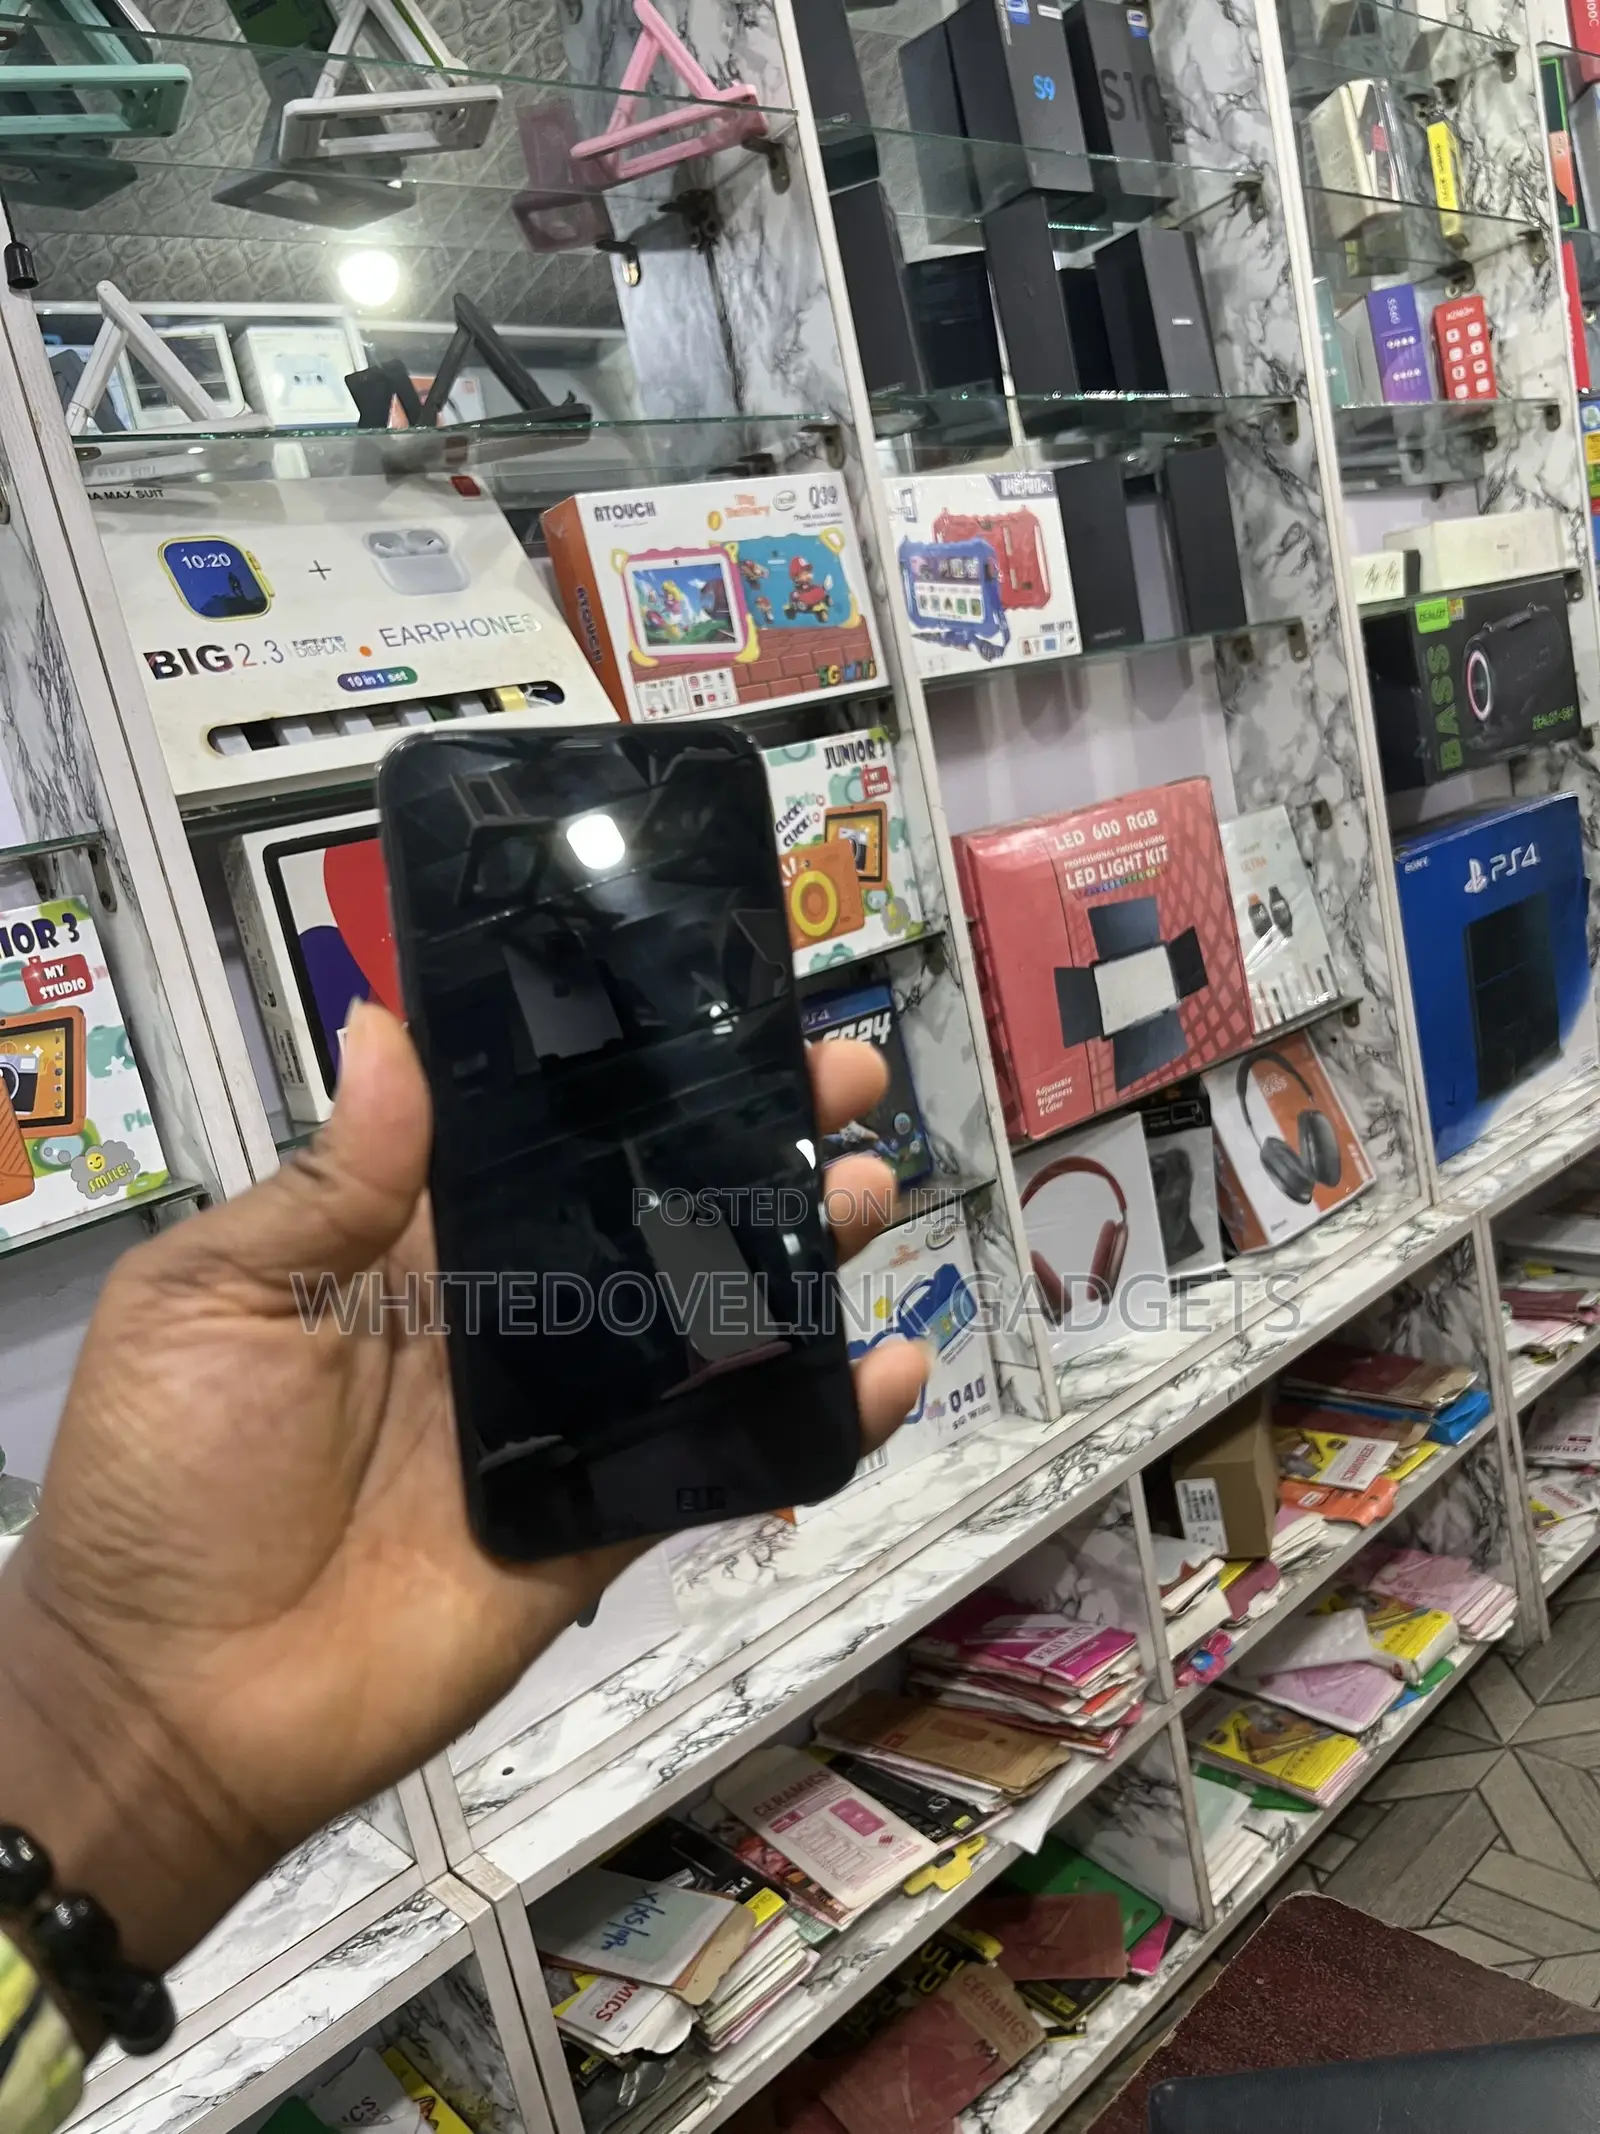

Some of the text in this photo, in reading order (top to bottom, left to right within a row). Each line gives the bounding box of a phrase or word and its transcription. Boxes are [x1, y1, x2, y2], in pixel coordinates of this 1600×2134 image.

[1032, 74, 1056, 101] S9
[1100, 68, 1165, 122] S10
[104, 490, 133, 500] MAX
[135, 488, 164, 499] SUIT
[181, 553, 231, 569] 10:20
[379, 612, 540, 648] EARPHONES
[143, 639, 284, 680] BIG 2.3
[1426, 643, 1463, 771] BASS
[823, 738, 876, 770] JUNIOR
[1054, 809, 1158, 850] LED 600 RGB
[1065, 867, 1096, 890] LED
[1099, 852, 1142, 880] LIGHT
[1144, 844, 1169, 867] KIT
[1490, 842, 1540, 881] PS4
[62, 912, 80, 943] 3
[40, 978, 86, 999] STUDIO
[44, 963, 65, 980] MY
[87, 1161, 132, 1193] SMILE!
[949, 1378, 986, 1413] Q40
[963, 1972, 1035, 2044] CERAMICS
